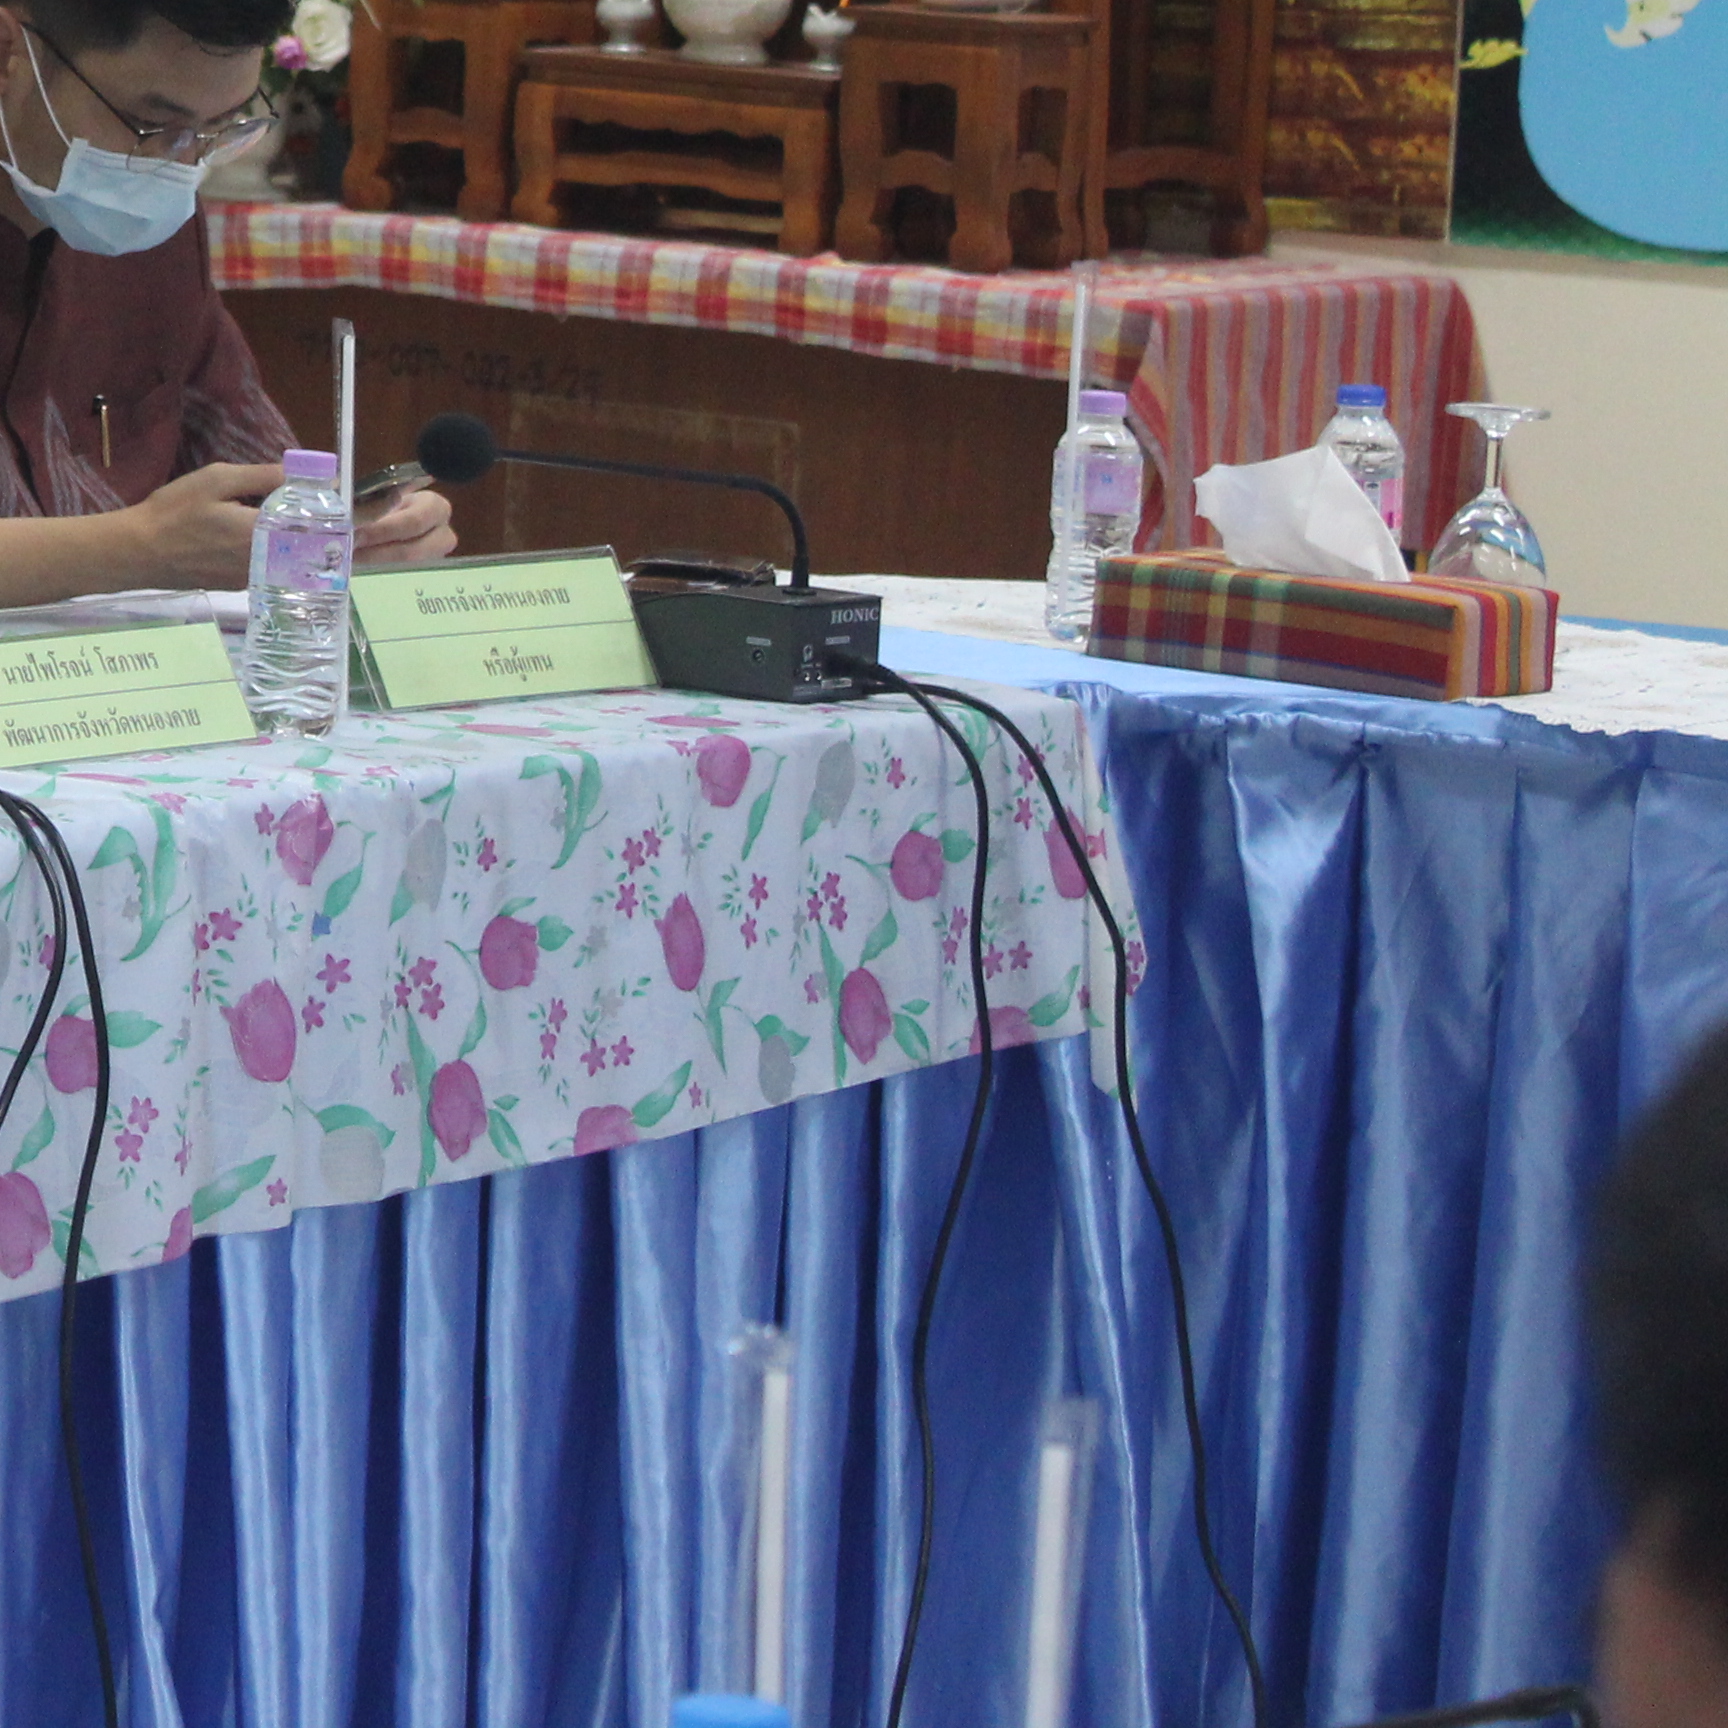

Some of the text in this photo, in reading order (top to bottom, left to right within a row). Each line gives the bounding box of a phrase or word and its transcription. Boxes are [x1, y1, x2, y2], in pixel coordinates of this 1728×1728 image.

[415, 584, 571, 615] อัยการจังหวัดหนองคาย
[2, 646, 160, 685] นายไพโรจน์ โสภาพร
[482, 646, 554, 682] หรือผู้แทน
[2, 705, 202, 748] พัฒนาการจังหวัดหนองคาย
